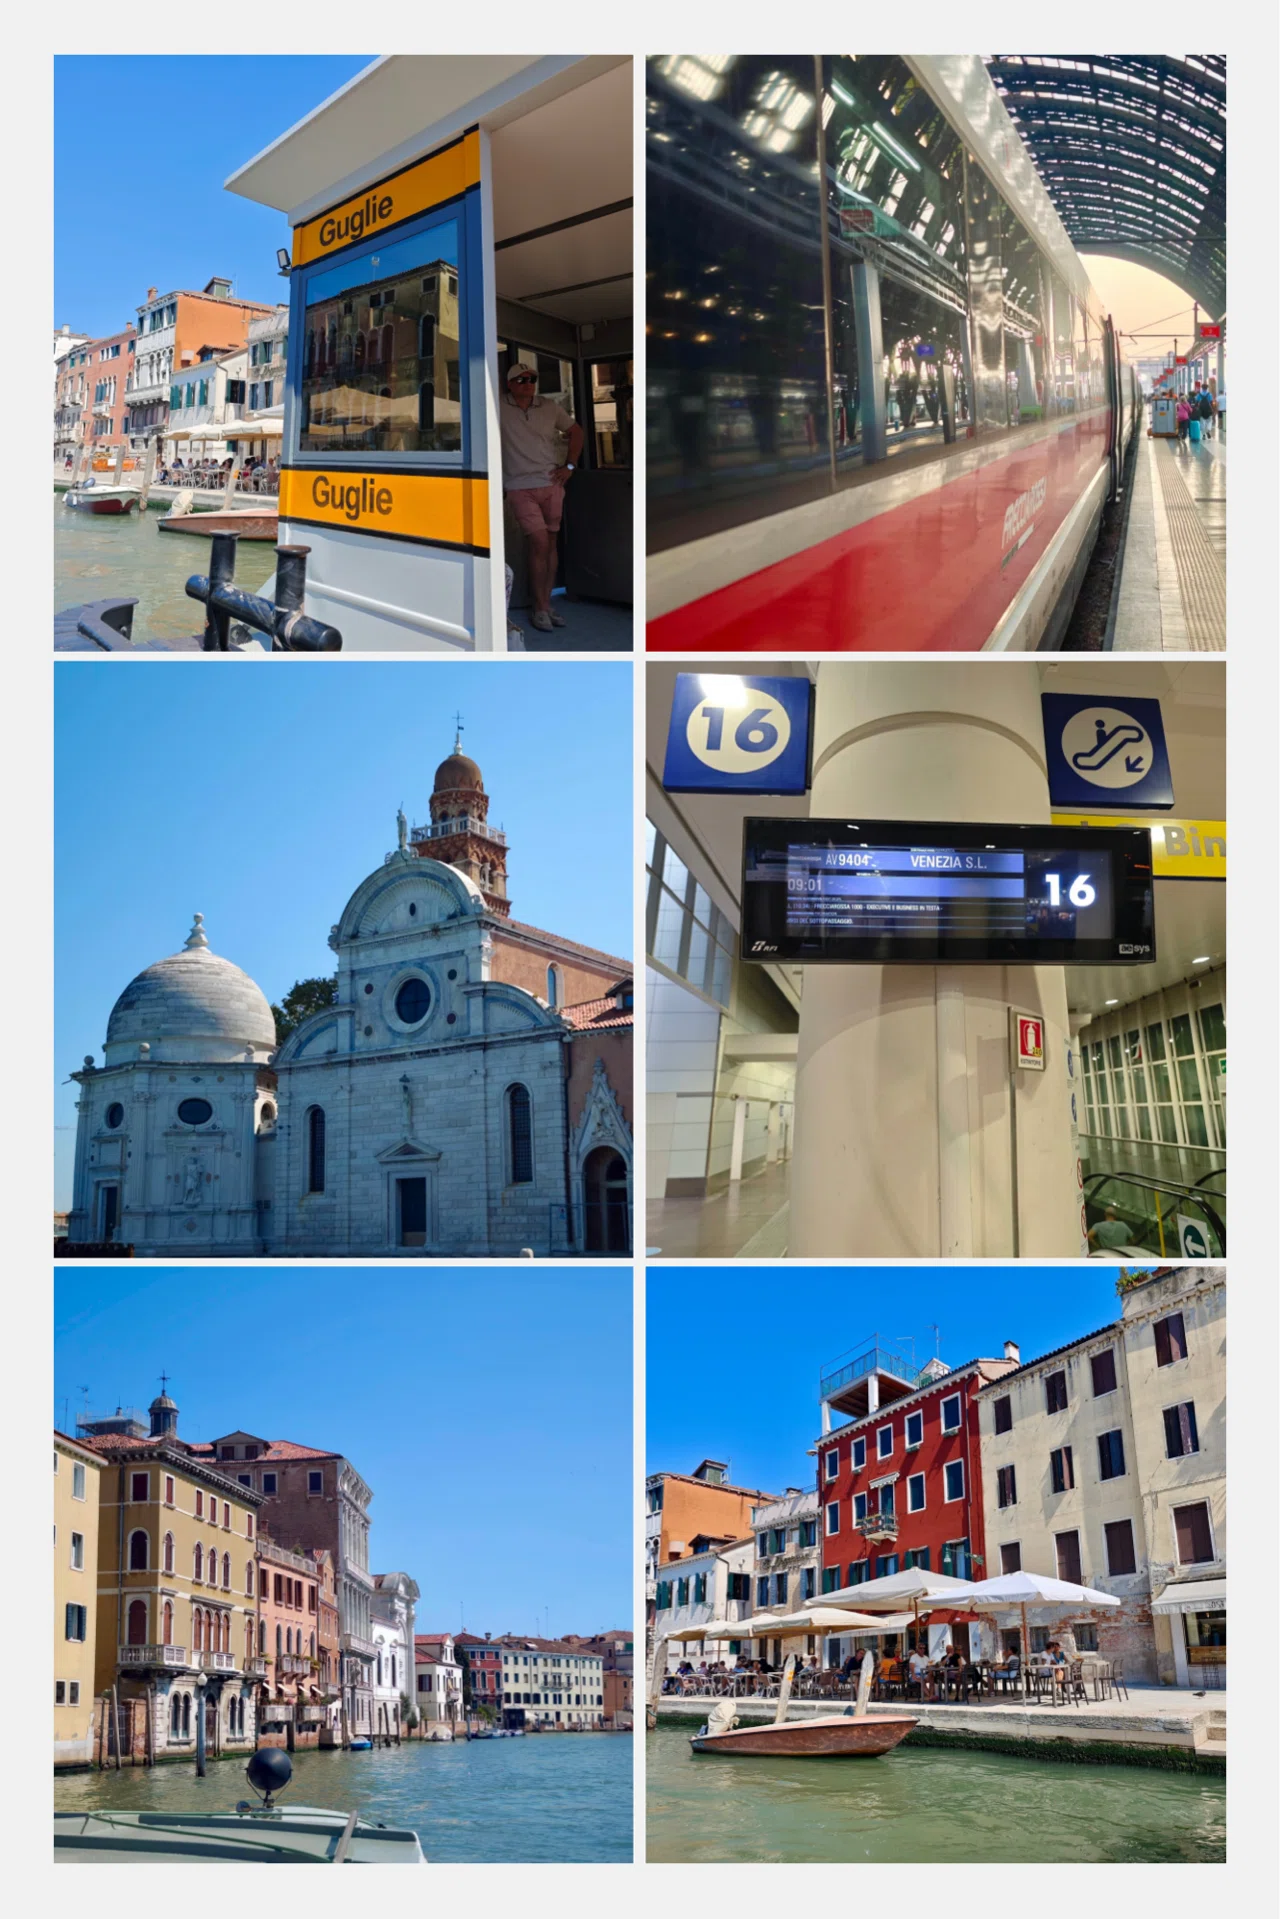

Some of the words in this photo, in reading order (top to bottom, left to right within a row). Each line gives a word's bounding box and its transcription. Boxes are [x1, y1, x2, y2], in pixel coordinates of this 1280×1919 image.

[319, 195, 393, 247] Guglie
[312, 475, 393, 521] Guglie
[701, 706, 779, 753] 16
[910, 855, 962, 868] VENEZIA
[965, 856, 987, 869] S.L.
[787, 878, 822, 891] 09:01
[1045, 873, 1096, 908] 16
